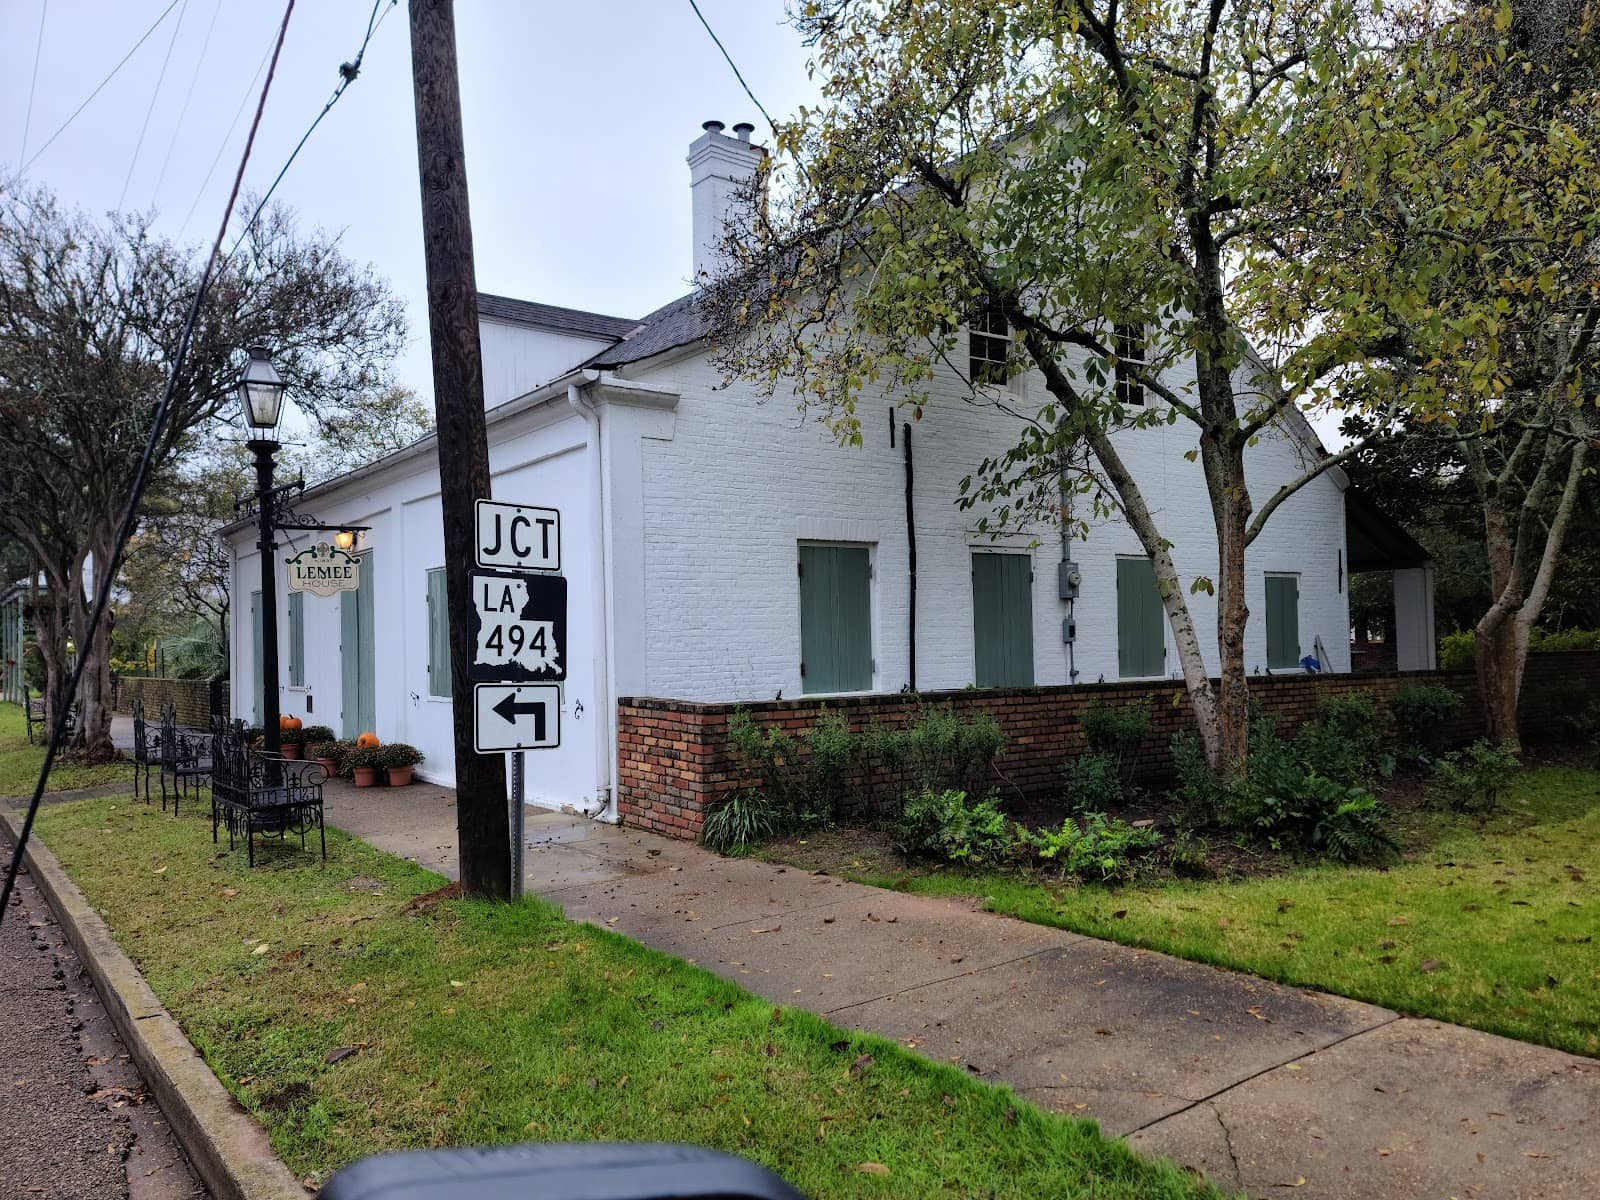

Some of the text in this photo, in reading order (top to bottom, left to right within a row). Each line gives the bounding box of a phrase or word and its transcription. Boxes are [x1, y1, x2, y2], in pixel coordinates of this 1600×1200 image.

[482, 513, 555, 559] JCT
[296, 566, 353, 579] LEMEE
[302, 579, 345, 588] HOUSE
[483, 583, 515, 613] LA
[485, 624, 547, 657] 494
